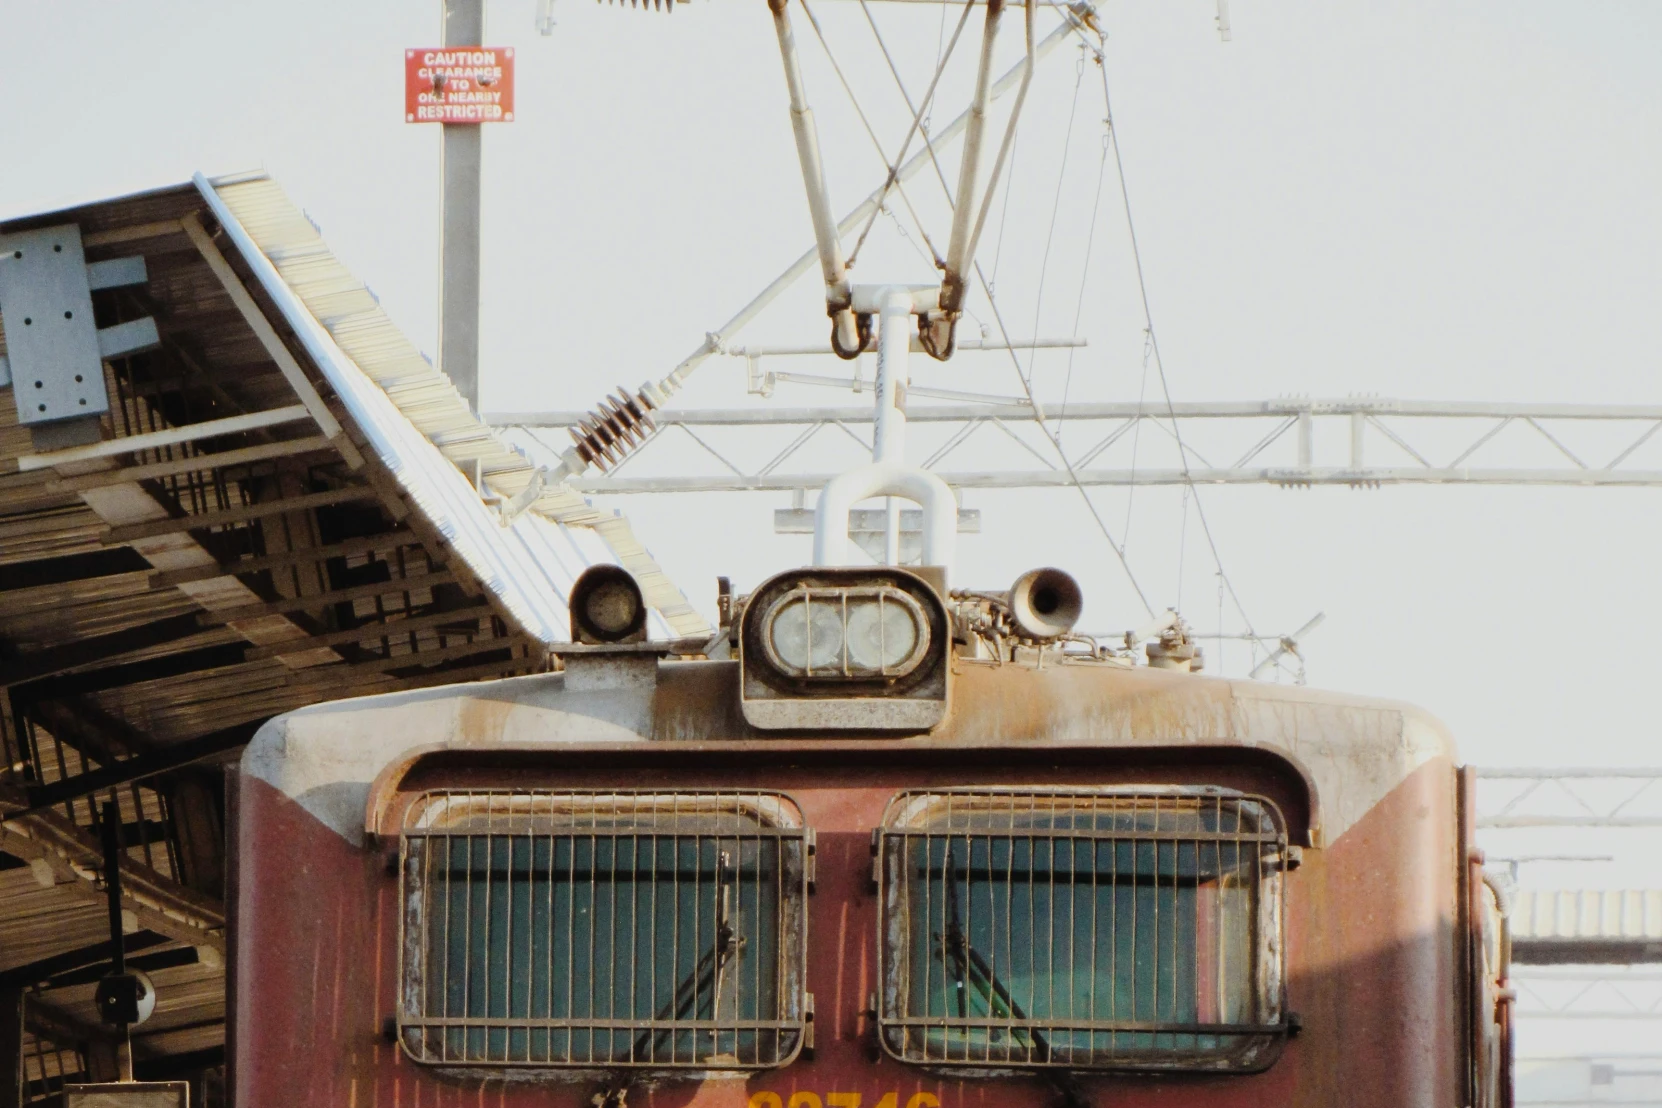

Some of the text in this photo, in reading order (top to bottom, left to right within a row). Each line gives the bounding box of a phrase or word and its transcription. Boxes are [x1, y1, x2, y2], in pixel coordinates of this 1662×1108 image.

[424, 52, 496, 65] CAUTION
[418, 67, 502, 78] CLEARANCE
[451, 80, 470, 90] TO
[448, 91, 501, 103] NEARBY
[418, 104, 502, 119] RESTRICTED
